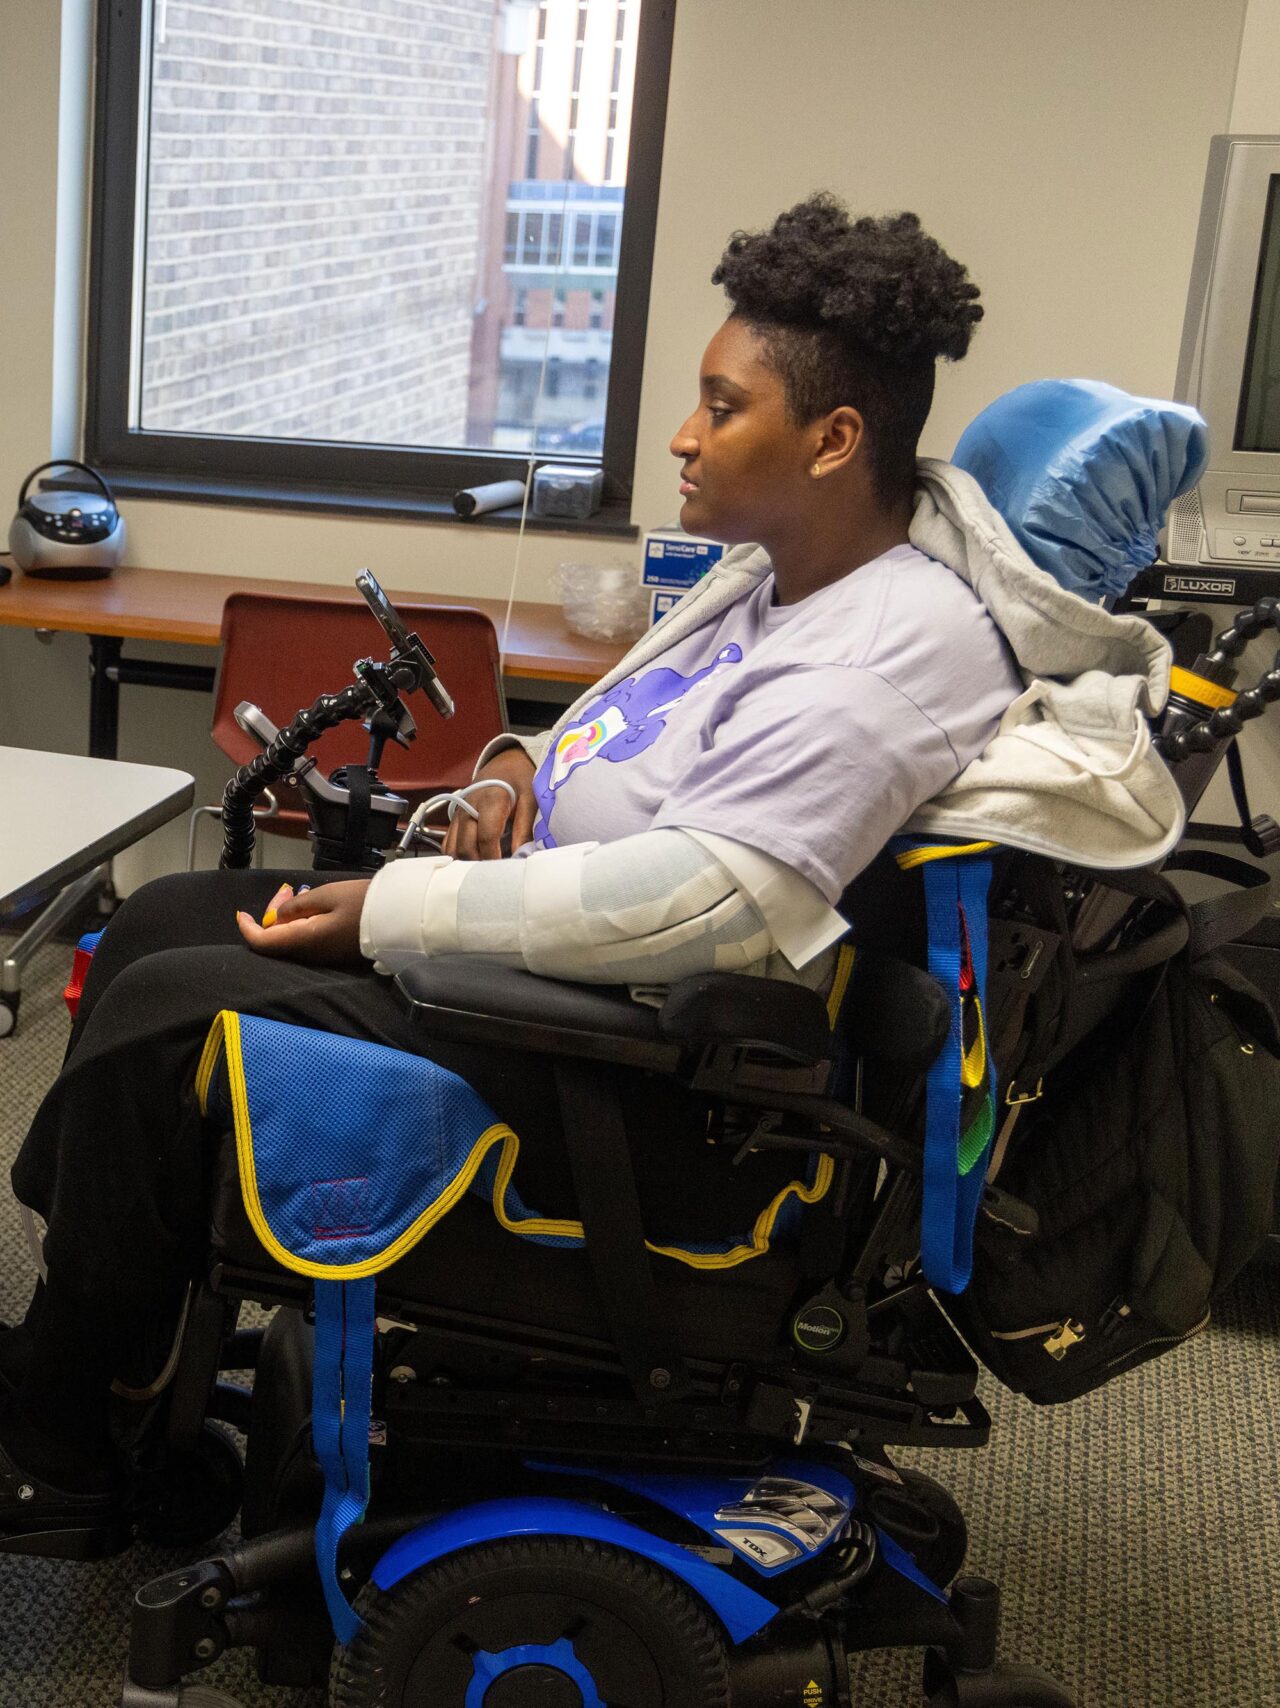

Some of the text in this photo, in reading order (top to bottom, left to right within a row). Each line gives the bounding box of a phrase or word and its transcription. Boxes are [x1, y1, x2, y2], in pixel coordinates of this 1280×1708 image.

[1181, 580, 1232, 592] LUXOR
[798, 1322, 830, 1335] Motion
[742, 1537, 768, 1557] TDX
[803, 1688, 822, 1696] PUSH
